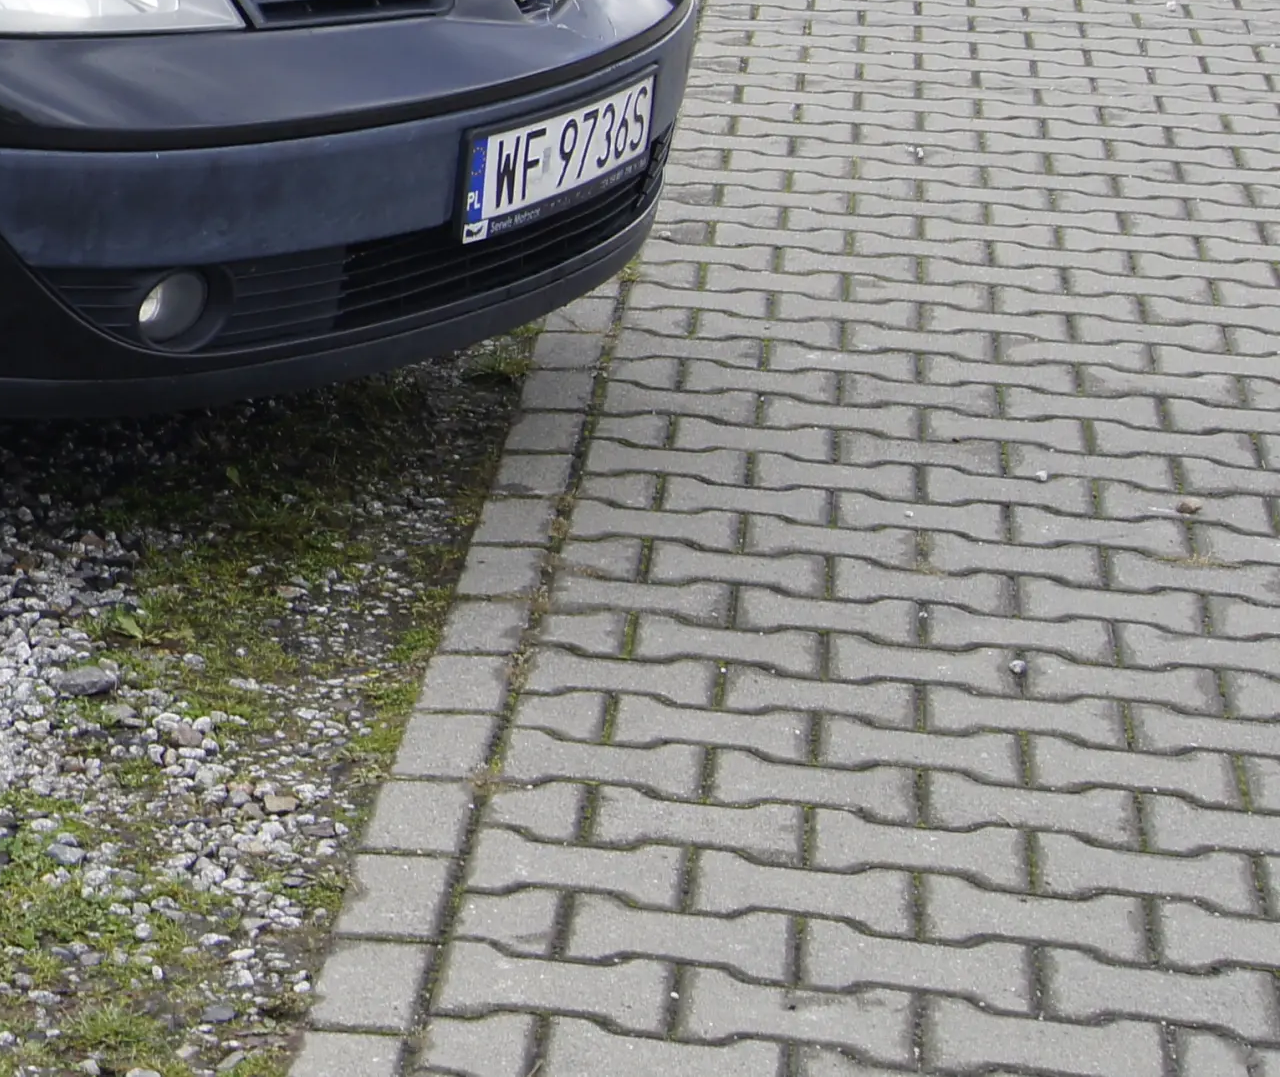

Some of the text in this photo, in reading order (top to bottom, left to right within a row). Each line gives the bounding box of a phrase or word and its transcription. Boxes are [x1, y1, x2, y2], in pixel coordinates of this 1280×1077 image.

[495, 85, 649, 210] WF 9736S
[466, 191, 482, 212] PL
